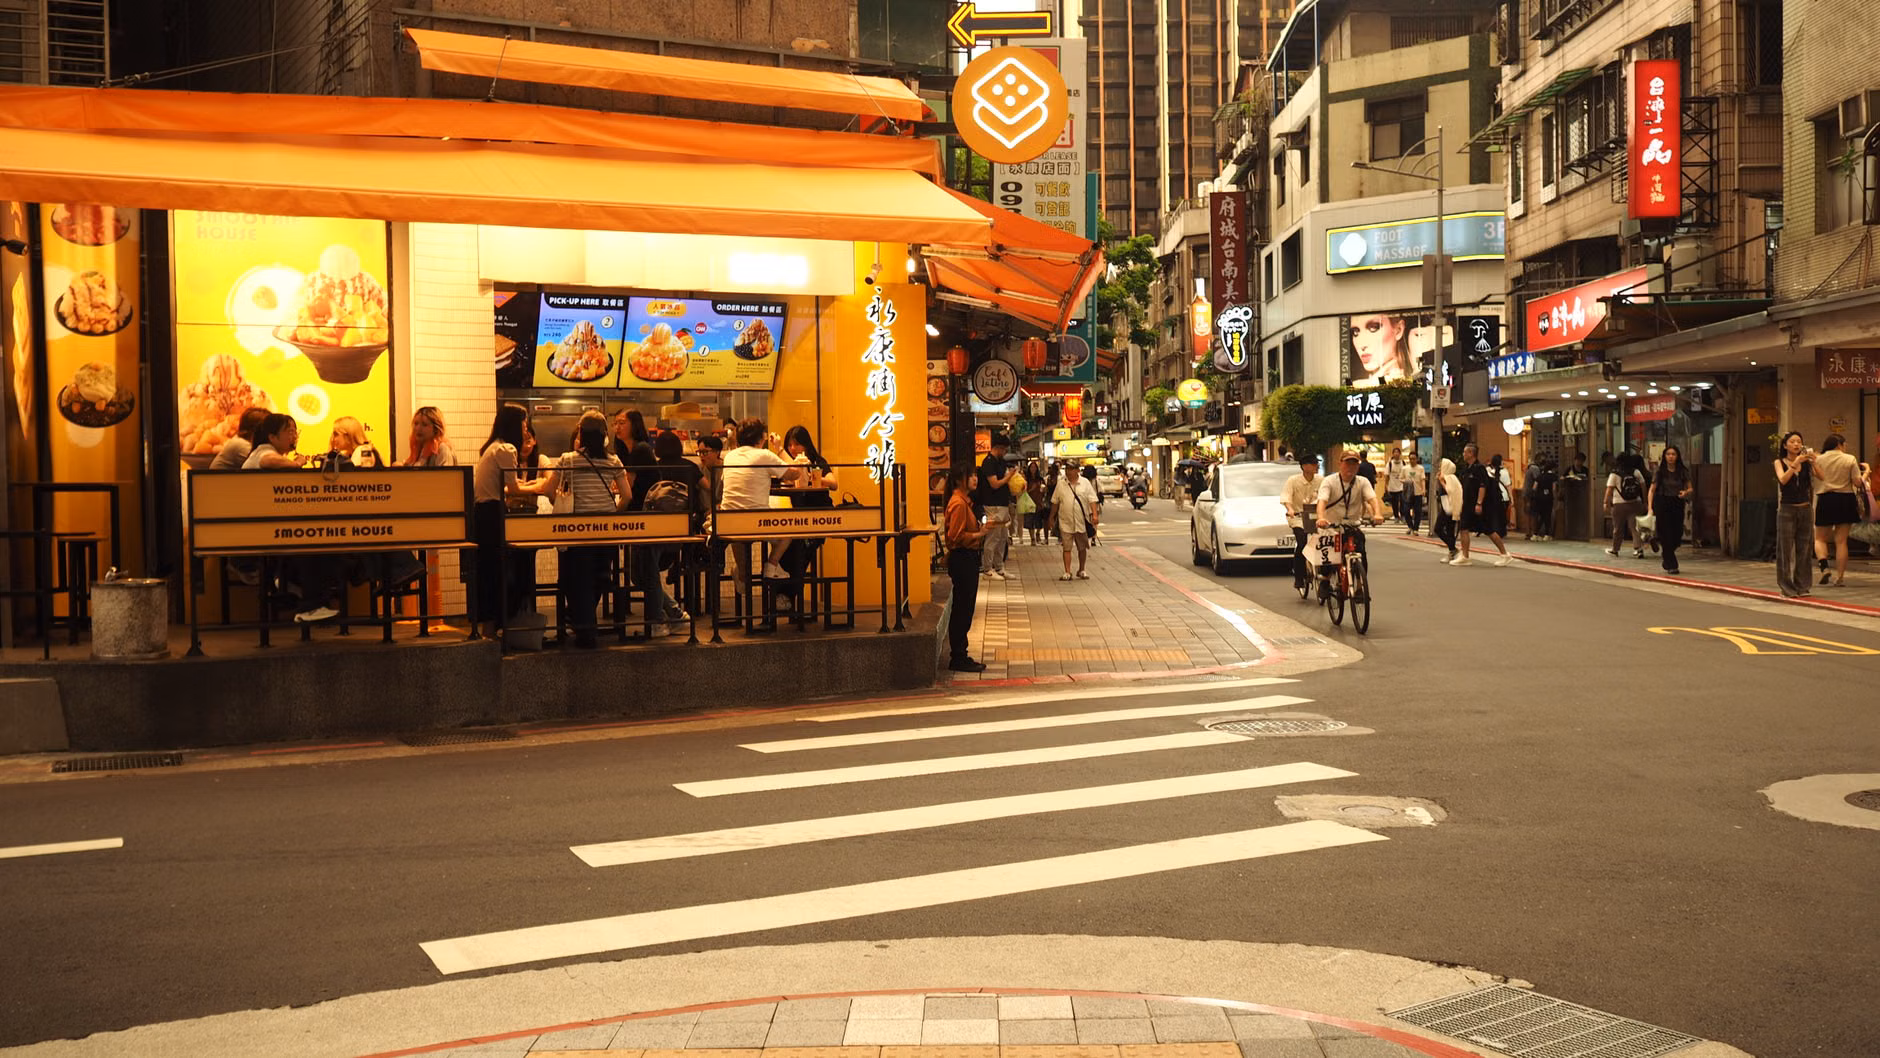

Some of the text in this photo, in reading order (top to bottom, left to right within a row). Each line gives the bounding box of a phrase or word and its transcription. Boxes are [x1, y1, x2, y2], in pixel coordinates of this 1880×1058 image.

[1642, 77, 1672, 166] 台灣一品
[1034, 182, 1071, 198] 可餐飲
[1034, 201, 1071, 217] 可登記
[196, 225, 257, 240] HOUSE
[1374, 229, 1404, 244] FOOT
[1374, 244, 1428, 261] MASSAGE
[549, 297, 600, 306] PICK-UP HERE
[716, 303, 759, 312] ORDER HERE
[1341, 318, 1349, 344] NAIL
[1346, 392, 1384, 412] 阿原
[1346, 413, 1383, 426] YUAN
[273, 483, 392, 495] WORLD RENOWNED
[370, 494, 392, 502] SHOP
[552, 522, 646, 533] SMOOTHIE HOUSE
[758, 517, 842, 527] SMOOTHIE HOUSE
[274, 525, 393, 538] SMOOTHIE HOUSE
